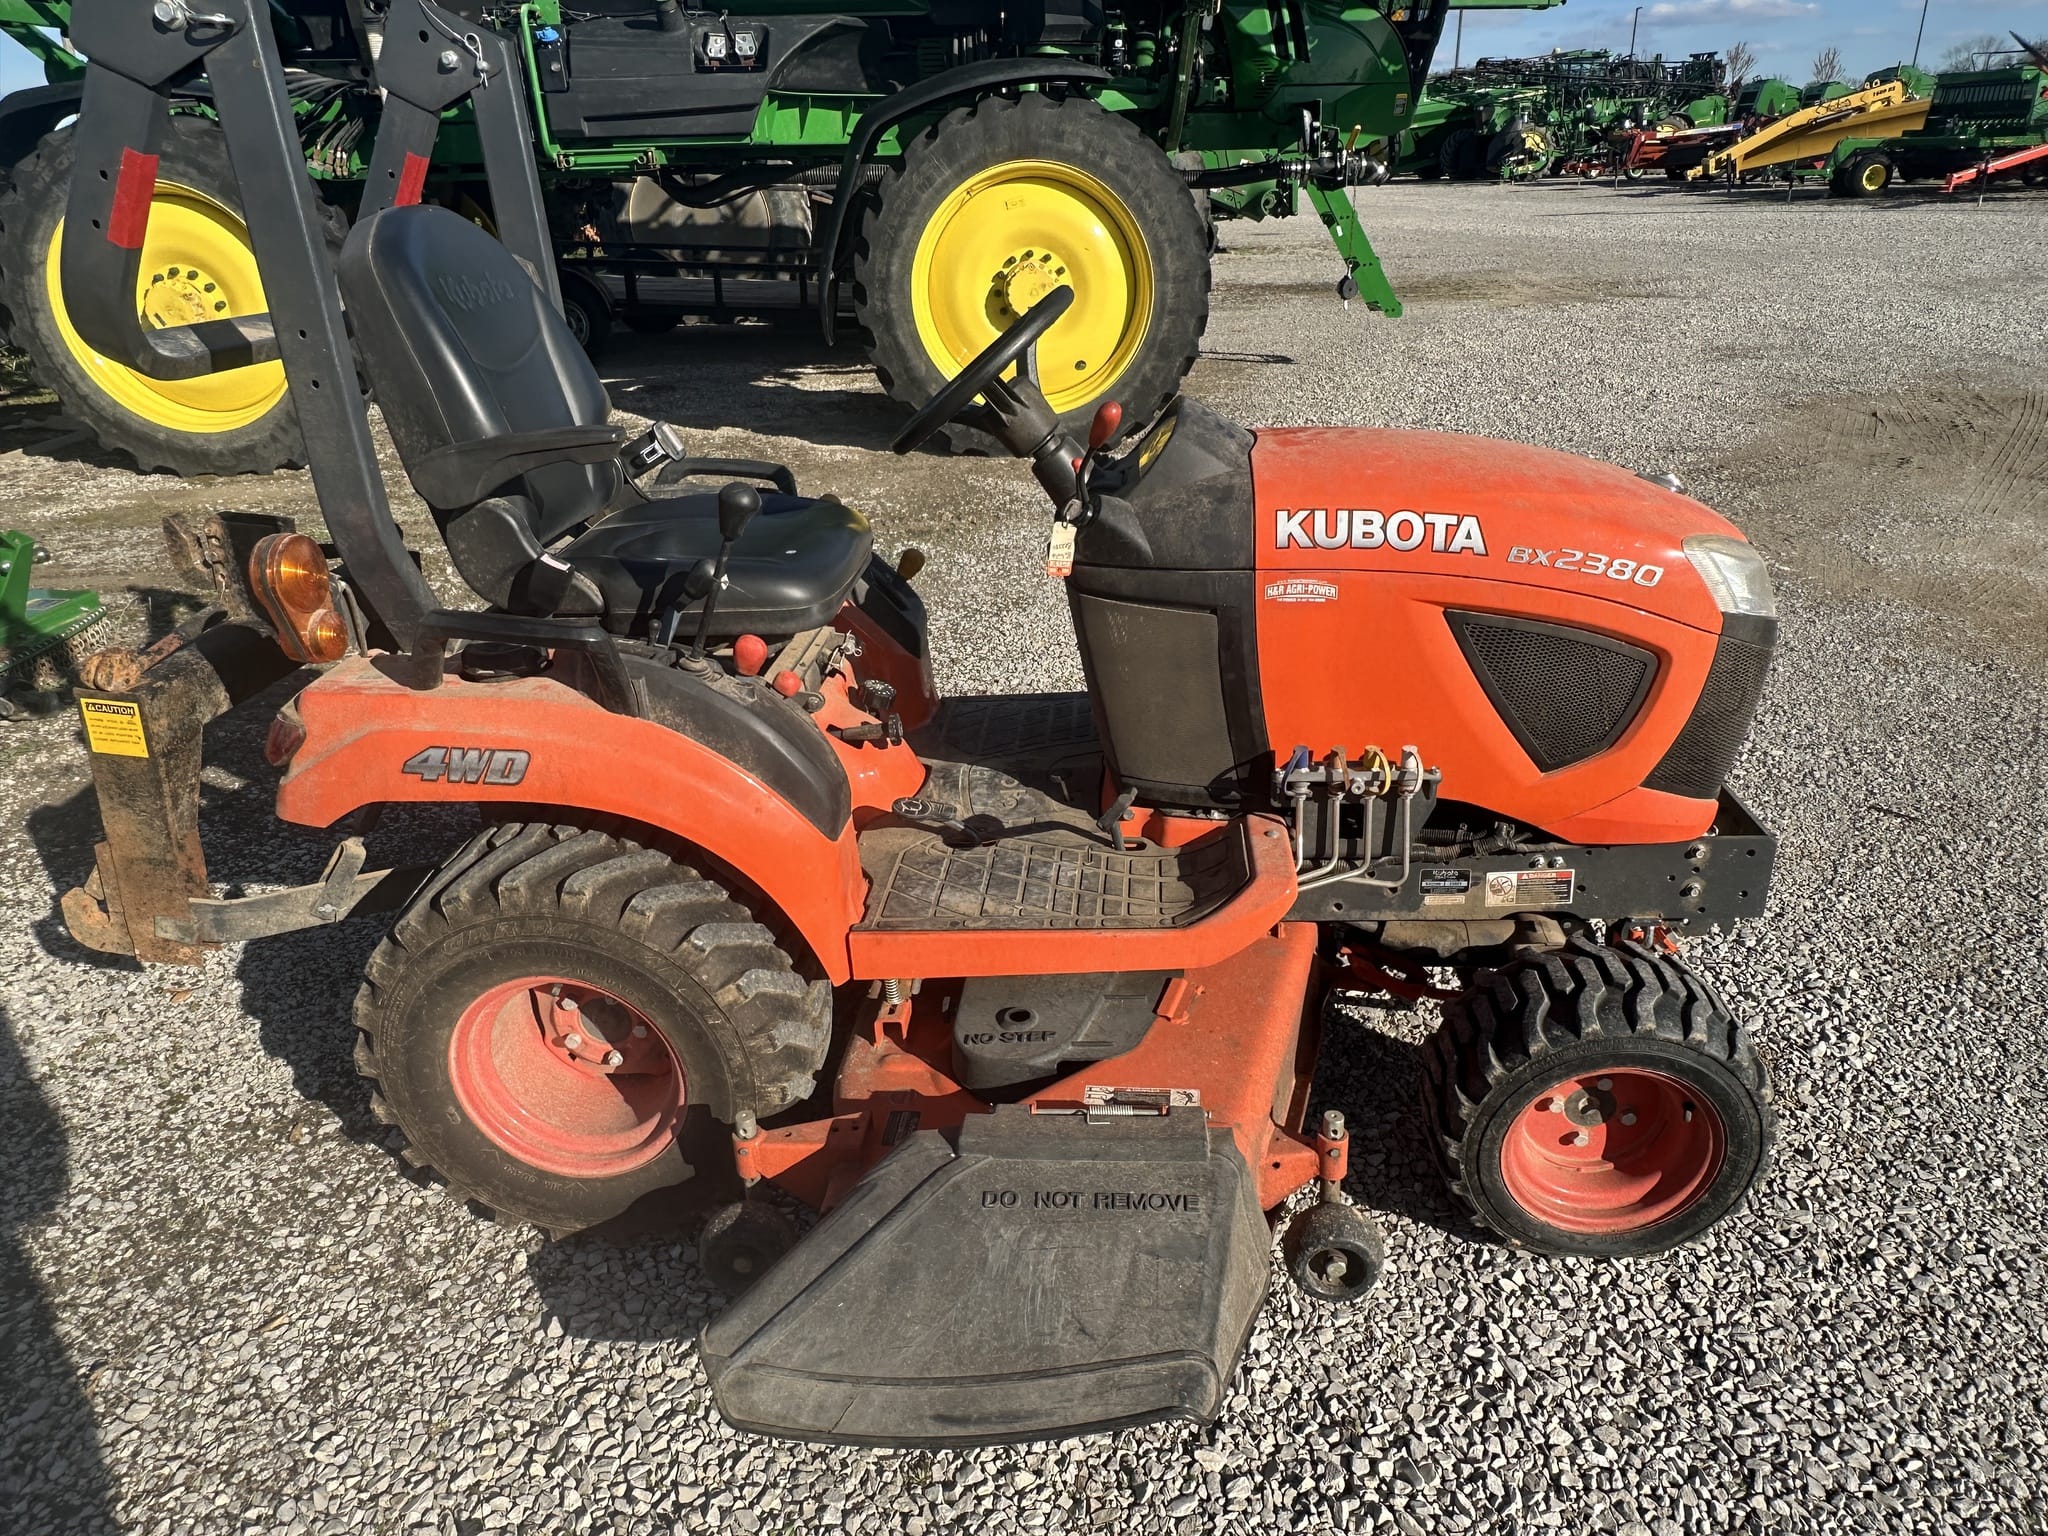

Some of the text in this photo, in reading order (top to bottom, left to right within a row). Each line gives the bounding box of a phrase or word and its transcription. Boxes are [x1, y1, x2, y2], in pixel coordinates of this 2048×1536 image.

[1275, 508, 1665, 587] KUBOTA BX2380
[95, 704, 134, 715] CAUTION
[401, 745, 532, 786] 4WD
[962, 1030, 1058, 1046] NO STEP
[981, 1190, 1203, 1214] DO NOT REMOVE
